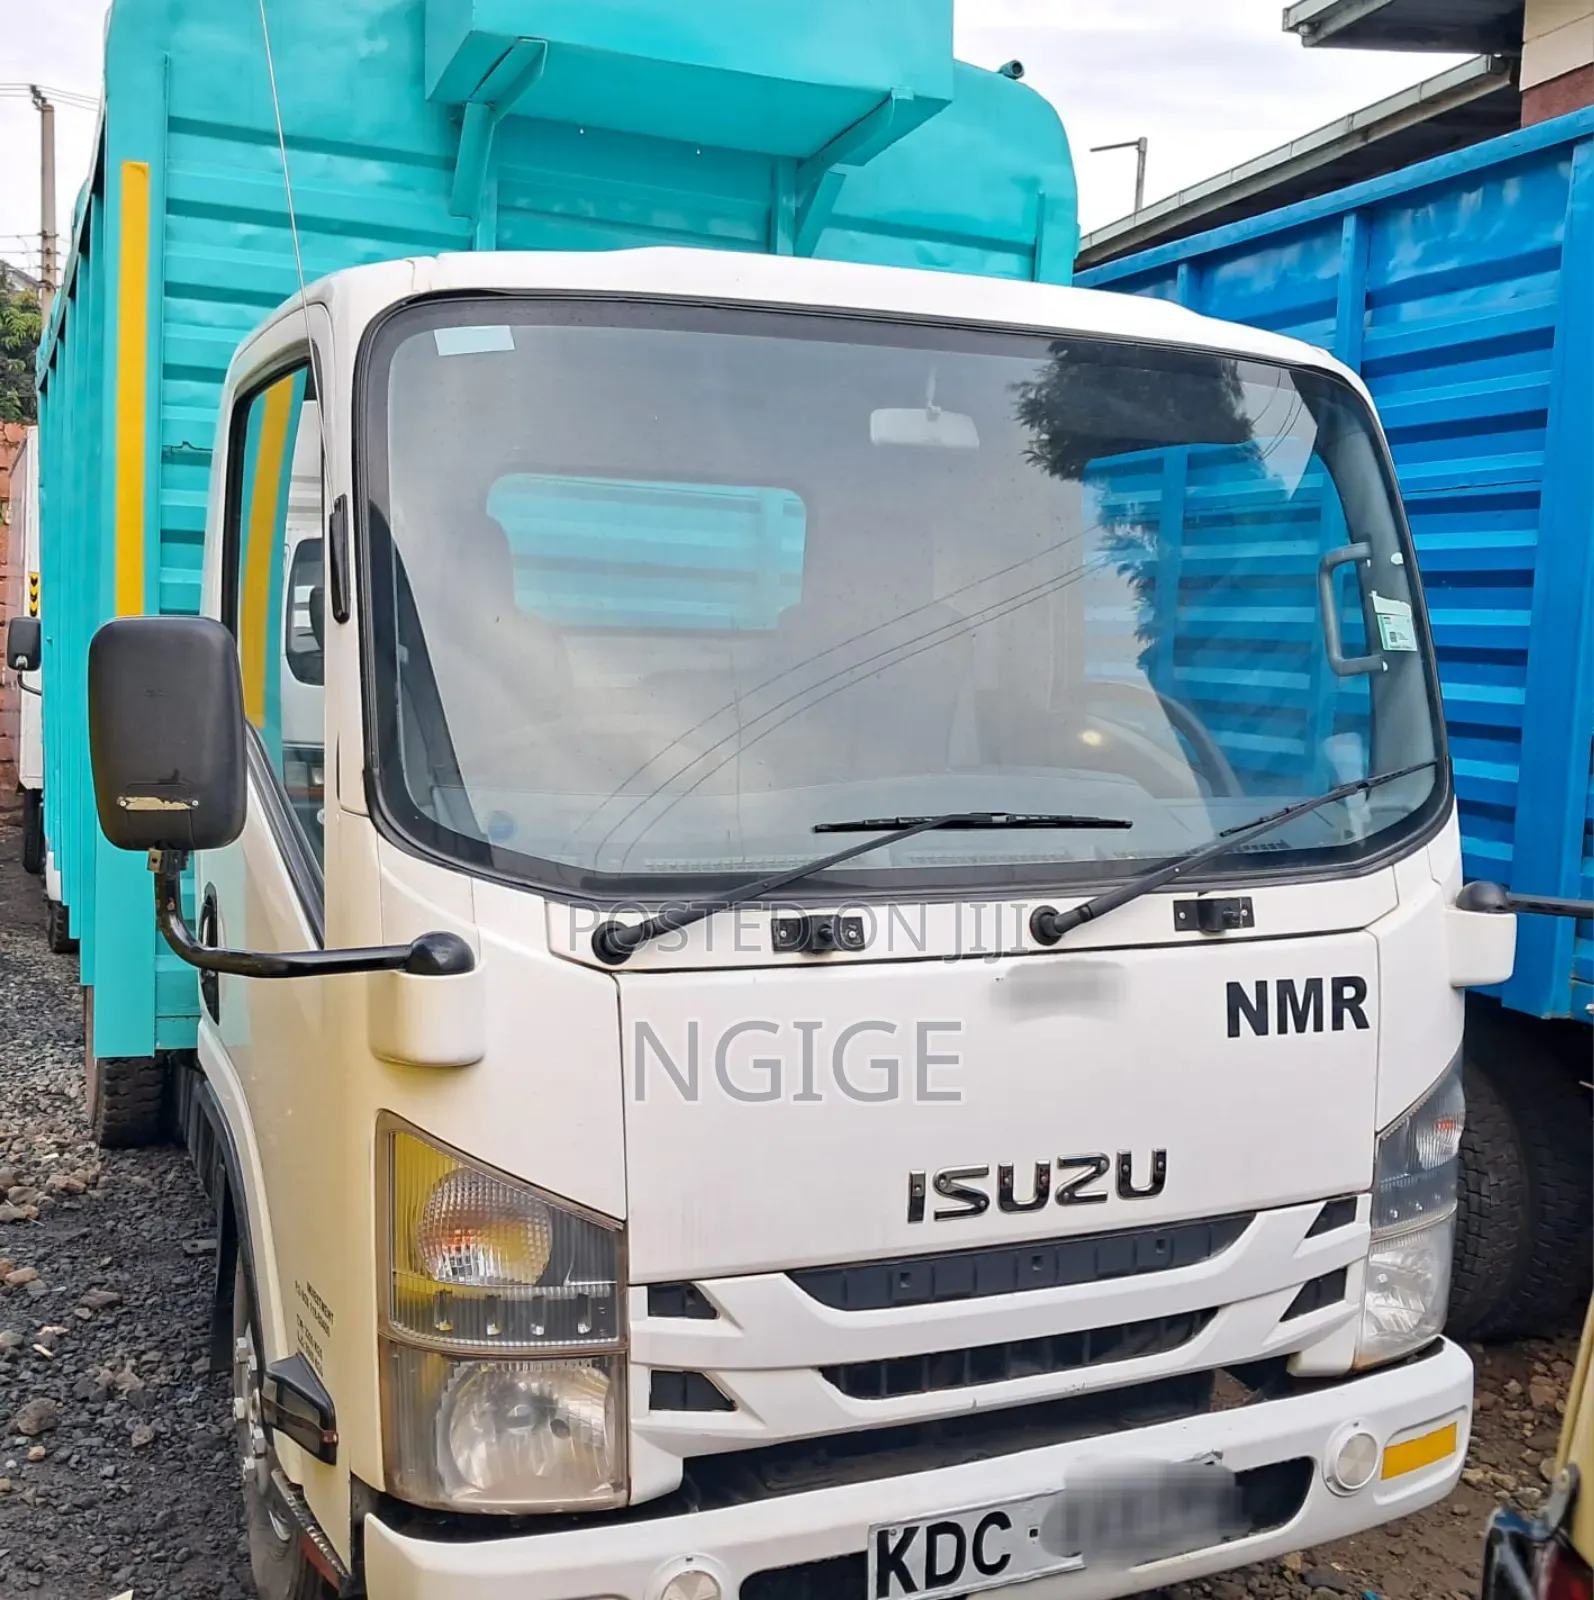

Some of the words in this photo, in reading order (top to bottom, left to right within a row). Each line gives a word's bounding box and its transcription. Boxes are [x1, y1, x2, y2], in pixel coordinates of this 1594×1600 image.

[1226, 975, 1370, 1038] NMR
[907, 1147, 1167, 1224] ISUZU
[876, 1511, 1012, 1599] KDC
